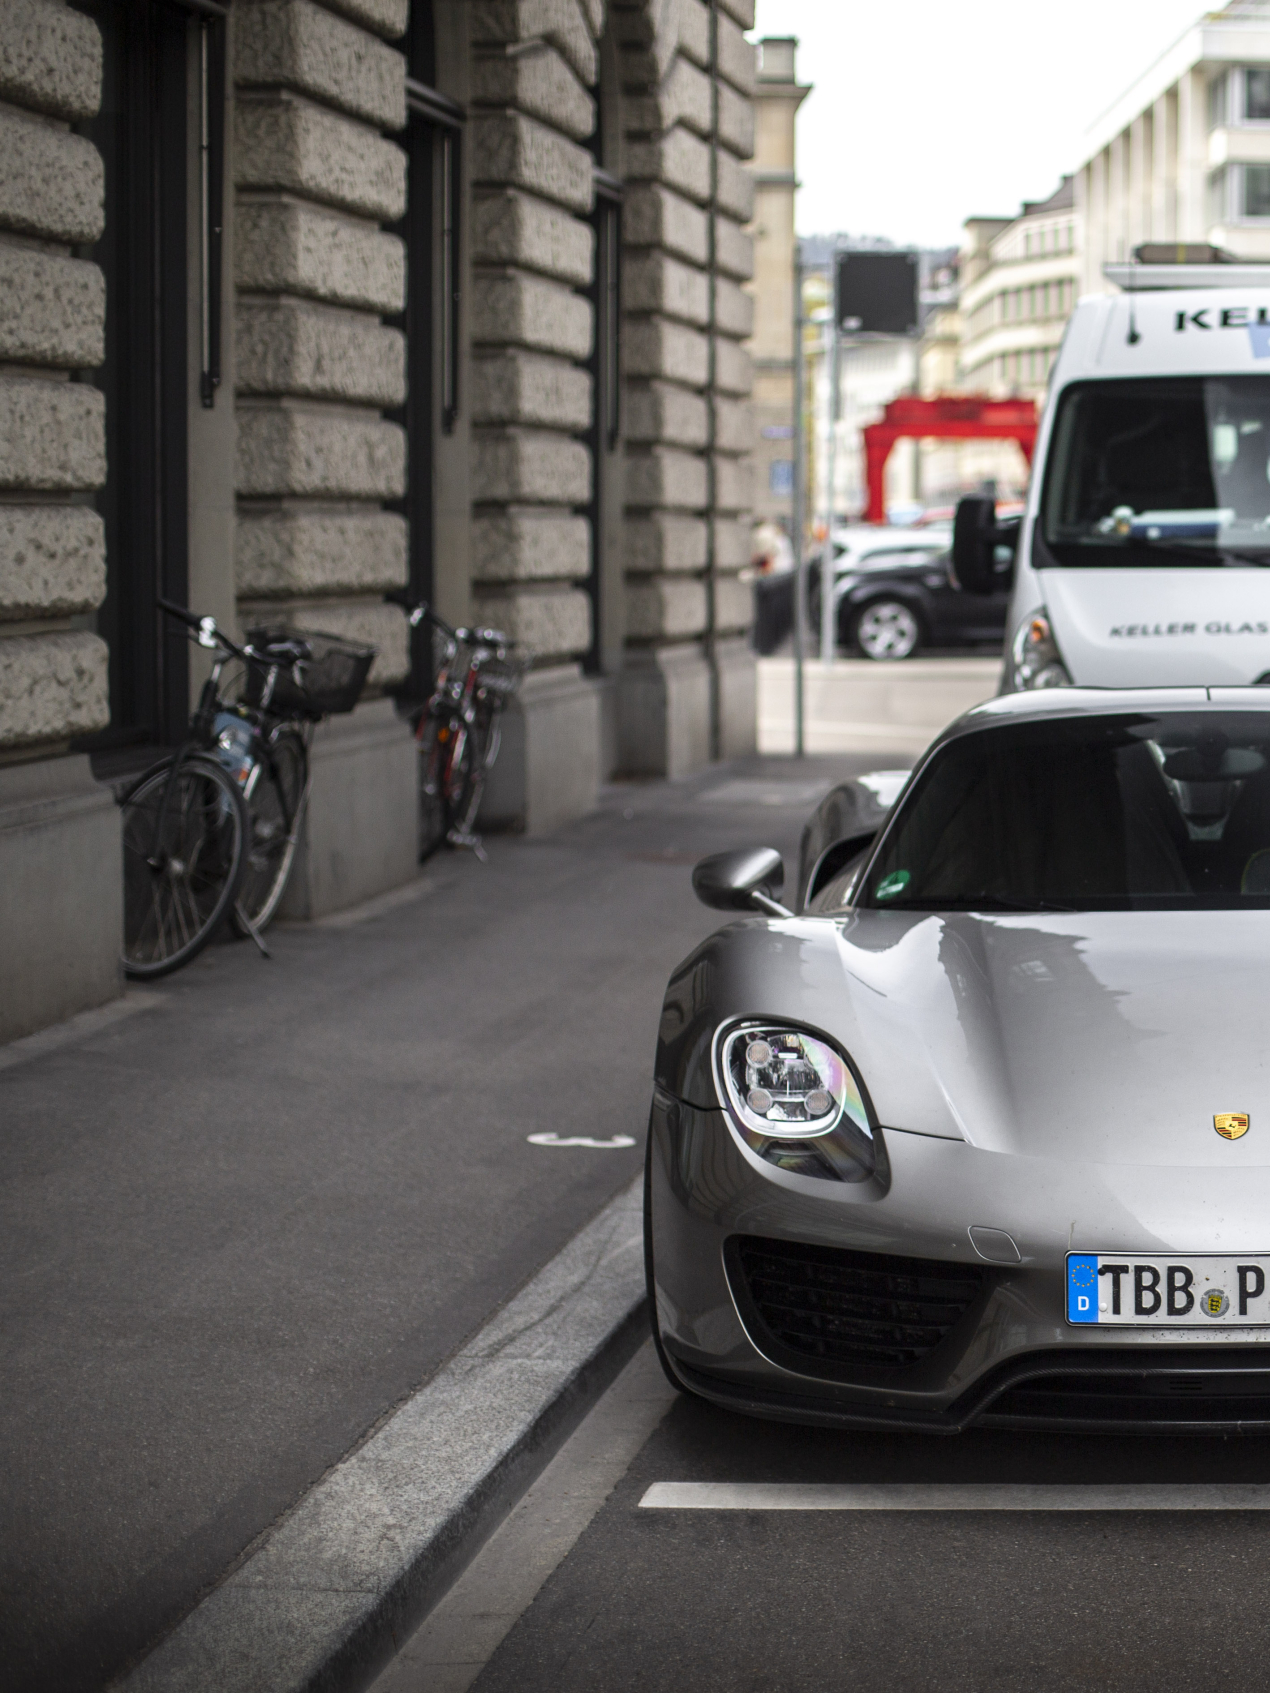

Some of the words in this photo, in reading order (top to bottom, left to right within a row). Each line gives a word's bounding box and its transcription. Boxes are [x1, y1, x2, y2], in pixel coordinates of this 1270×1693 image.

[1108, 621, 1198, 639] KELLER
[1204, 620, 1270, 635] GLAS
[1101, 1263, 1196, 1317] TBB
[1077, 1295, 1090, 1311] D
